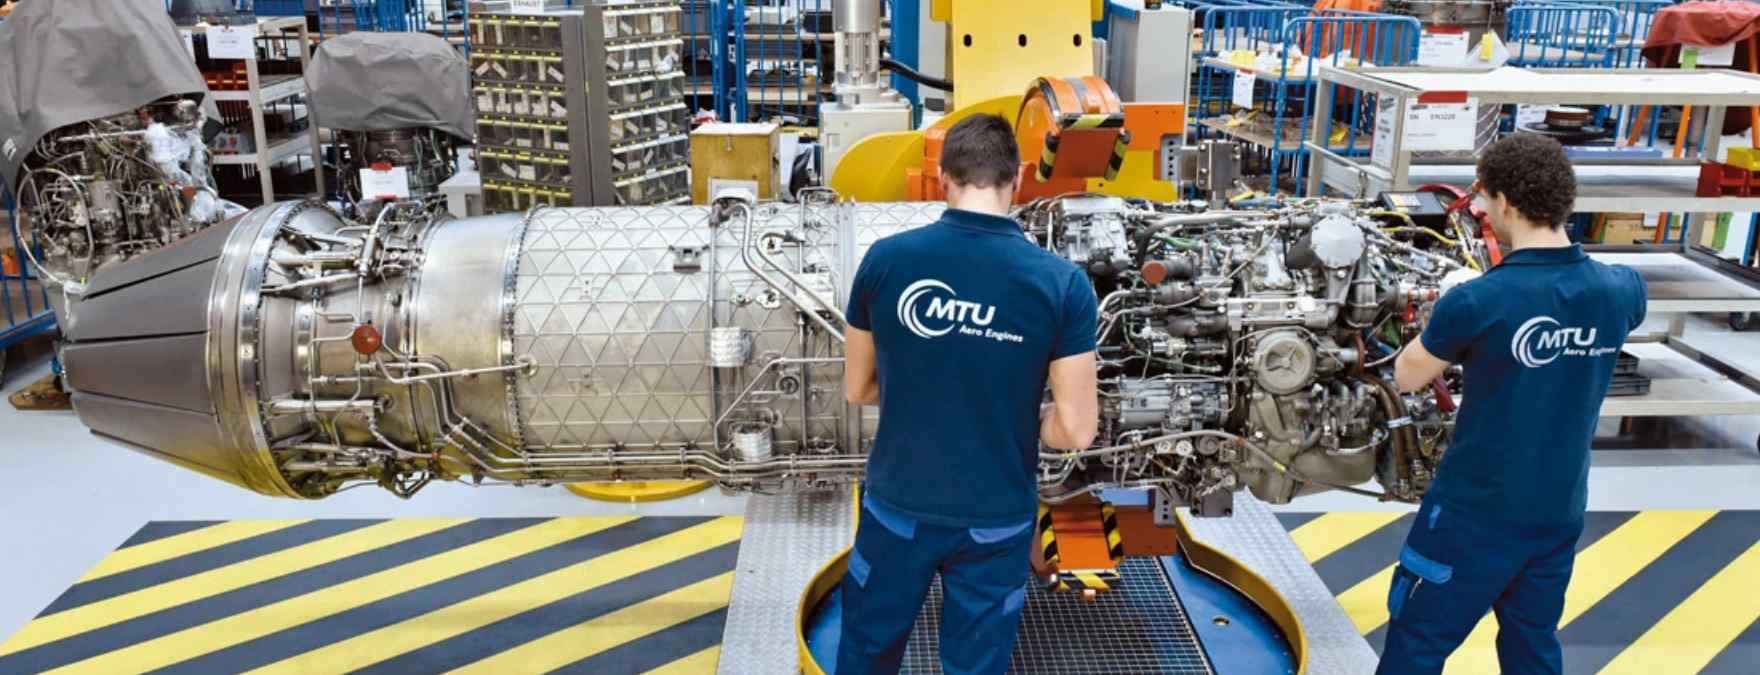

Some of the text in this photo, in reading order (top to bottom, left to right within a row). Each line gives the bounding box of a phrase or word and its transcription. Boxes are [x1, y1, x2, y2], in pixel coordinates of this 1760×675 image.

[925, 296, 996, 326] MTU
[959, 325, 1024, 342] Aero Engines
[1537, 327, 1597, 350] MTU
[1562, 347, 1586, 356] Aero
